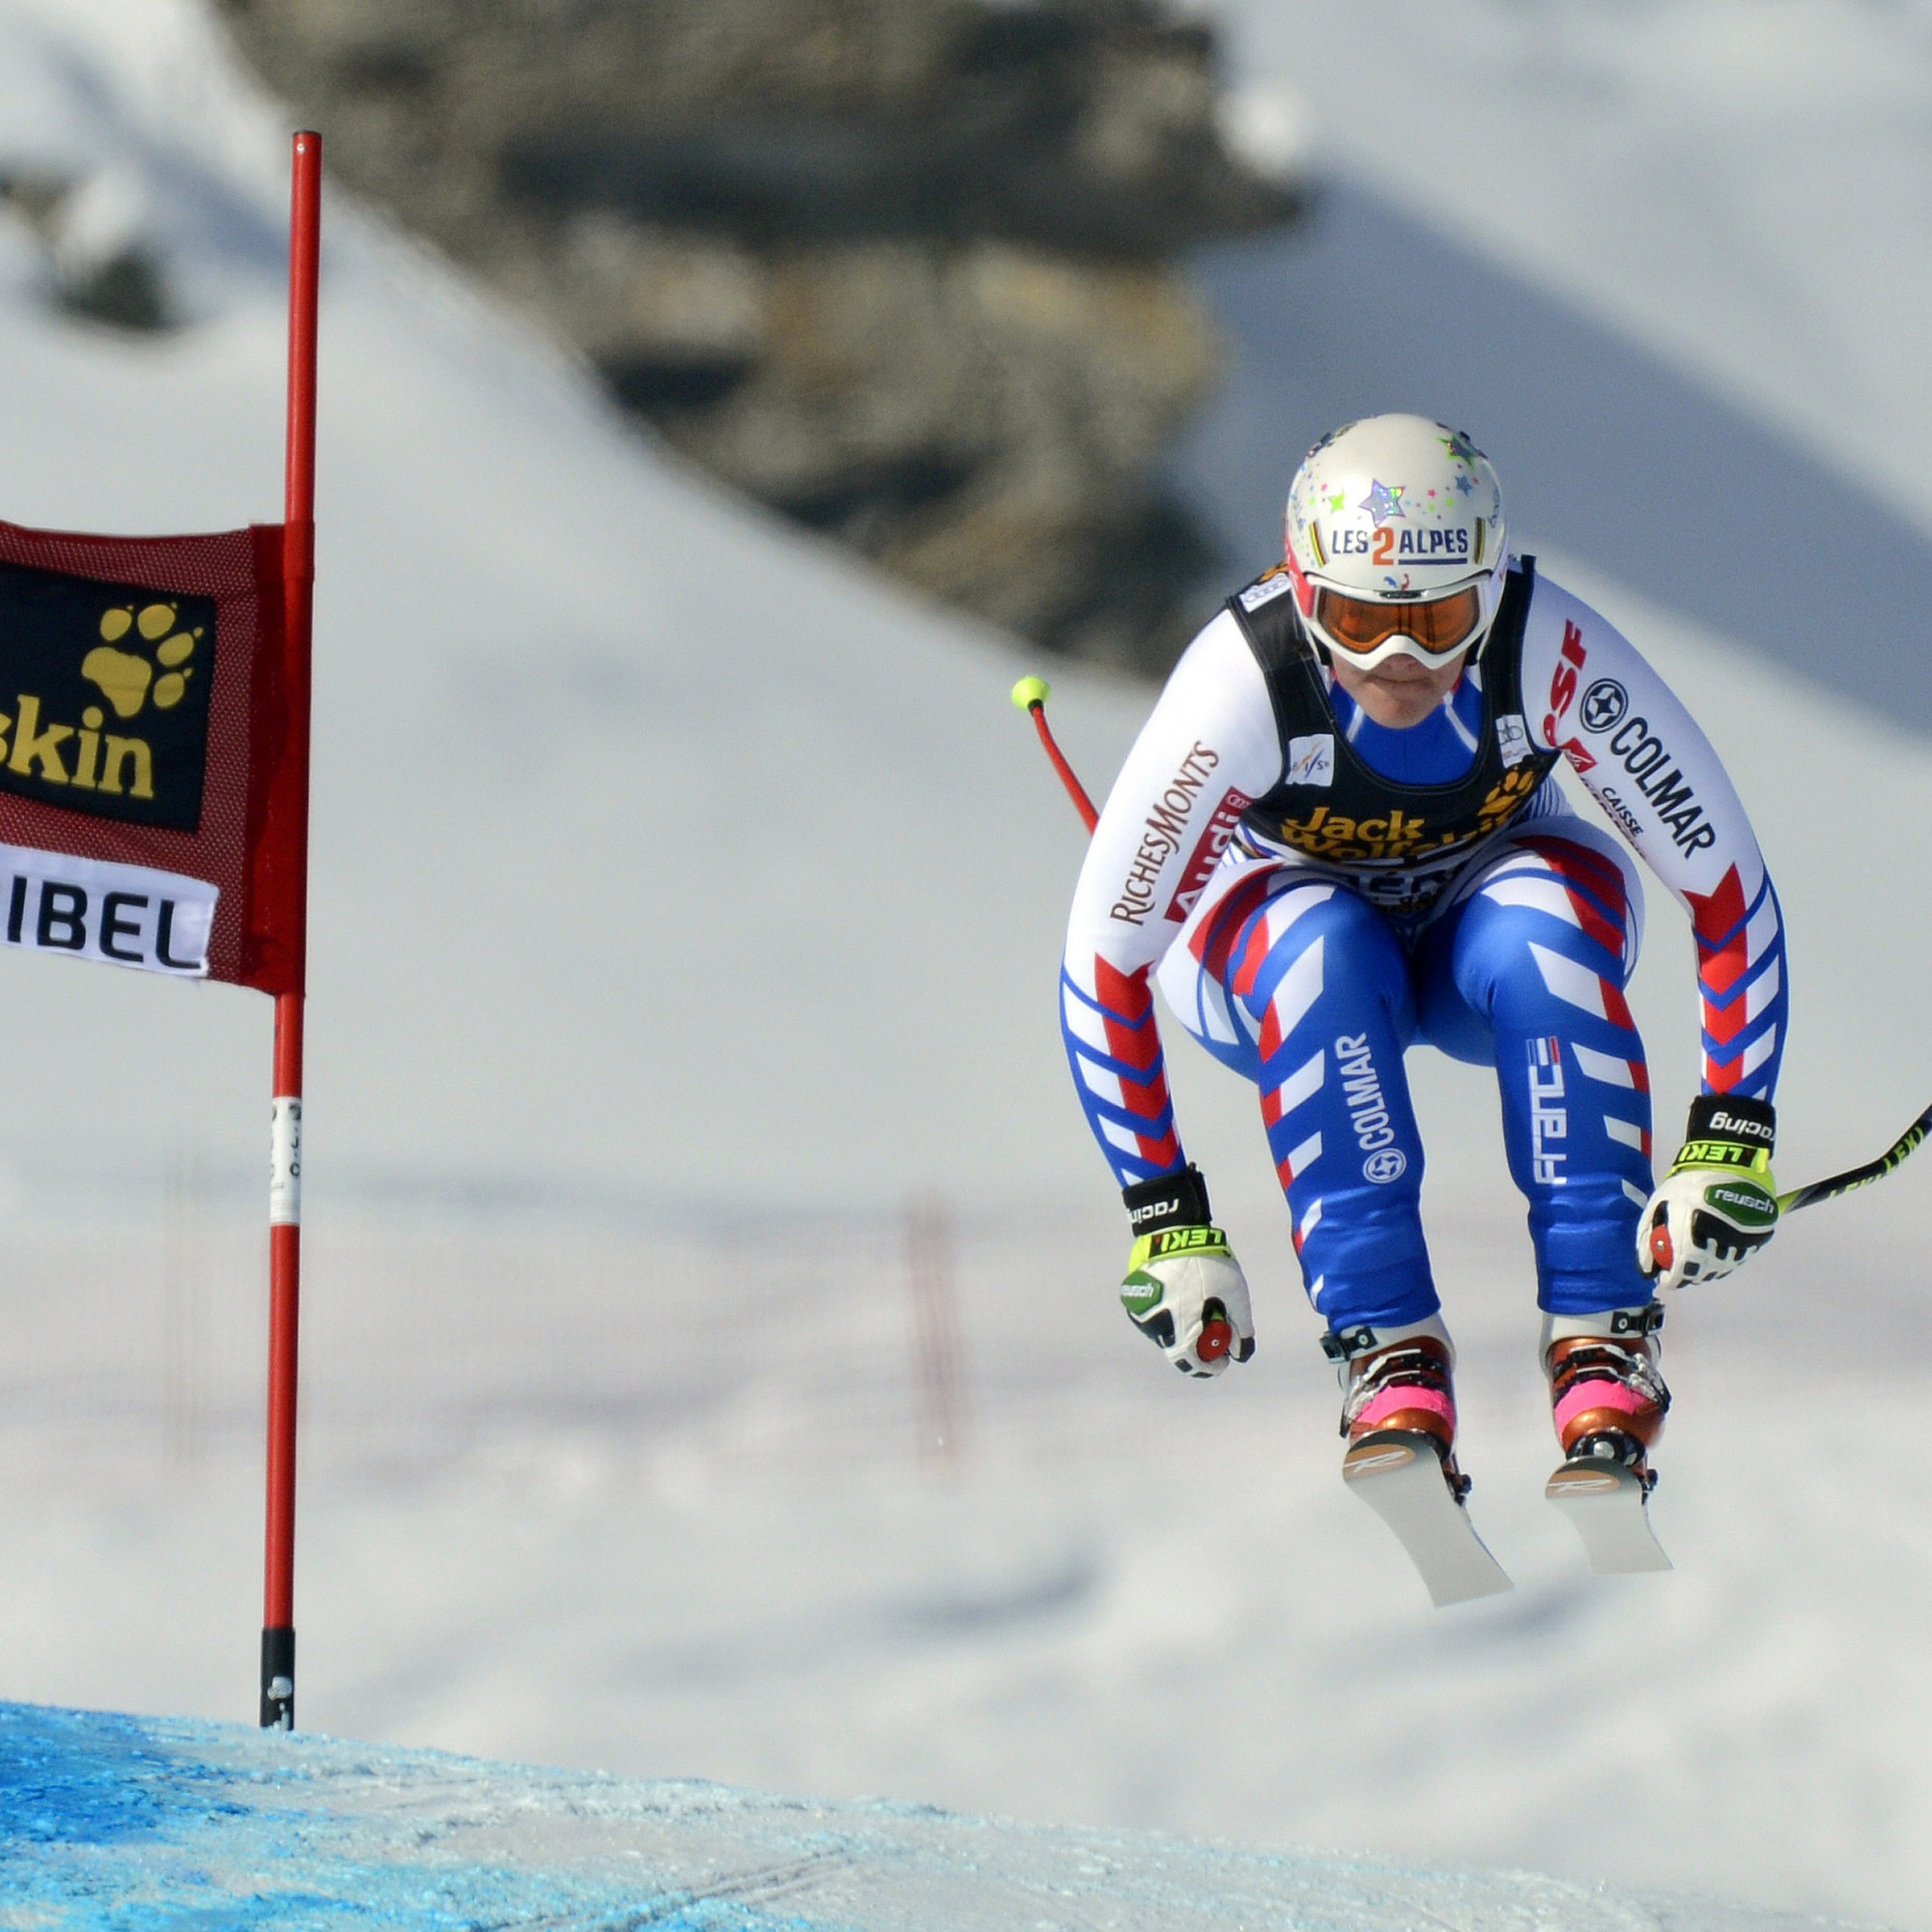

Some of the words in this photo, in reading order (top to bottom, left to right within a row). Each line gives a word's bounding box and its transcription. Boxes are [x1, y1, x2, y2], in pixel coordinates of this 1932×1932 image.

[1332, 529, 1369, 554] LES
[1372, 526, 1395, 566] 2
[1398, 527, 1469, 554] ALPES
[1610, 717, 1716, 859] COLMAR
[1285, 807, 1426, 843] Jack
[1602, 786, 1644, 837] CAISSE
[1110, 740, 1220, 925] RICHESMONTS
[8, 876, 202, 970] IBEL
[1334, 1032, 1395, 1151] COLMAR
[1709, 1111, 1776, 1142] racing
[1678, 1144, 1744, 1163] LEKI
[1126, 1198, 1179, 1224] racin
[1714, 1189, 1775, 1214] reusch
[1160, 1229, 1222, 1253] LEKI
